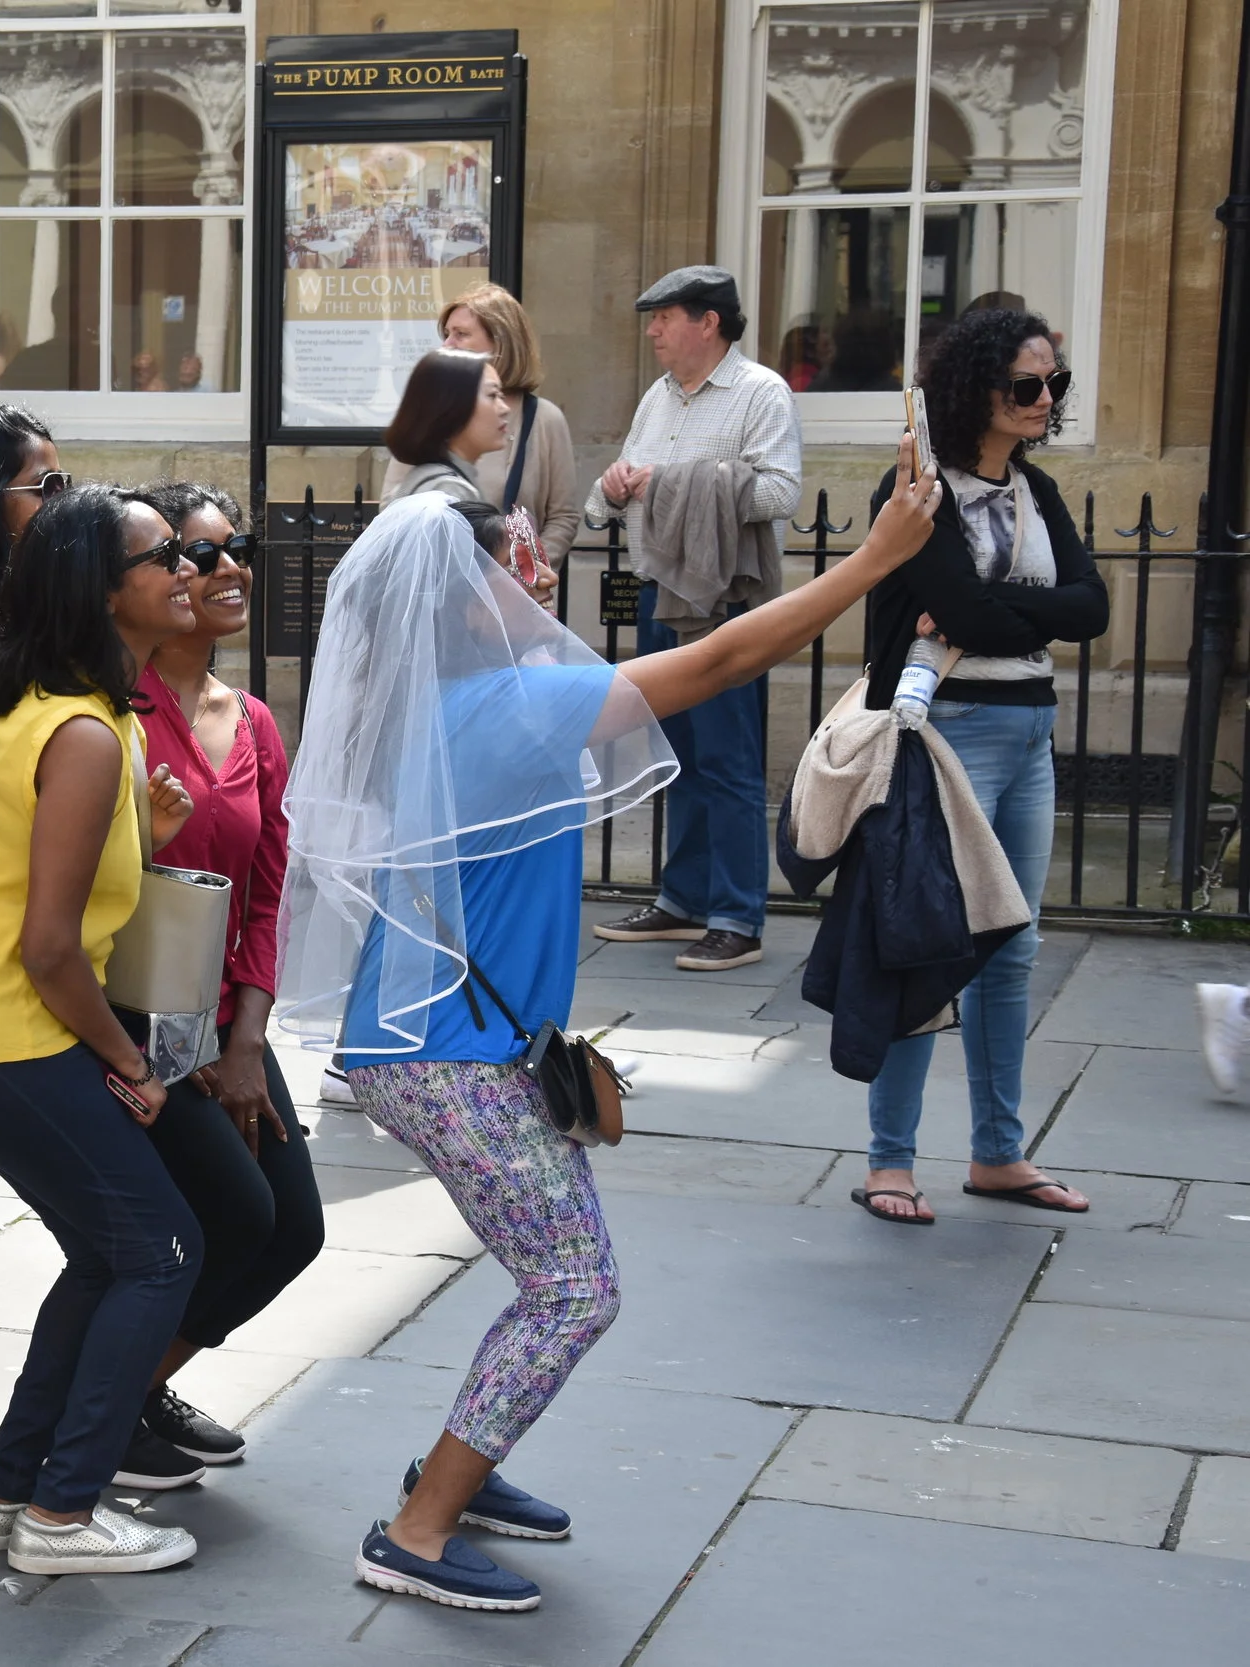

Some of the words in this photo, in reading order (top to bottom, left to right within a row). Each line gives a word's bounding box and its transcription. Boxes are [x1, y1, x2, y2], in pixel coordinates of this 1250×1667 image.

[274, 73, 302, 84] THE
[307, 68, 379, 87] PUMP
[388, 65, 464, 84] ROOM
[470, 68, 504, 79] BATH
[296, 275, 432, 296] WELCOME
[297, 301, 319, 314] TO
[323, 301, 353, 314] THE
[358, 300, 401, 314] PUMP
[407, 299, 444, 314] ROO
